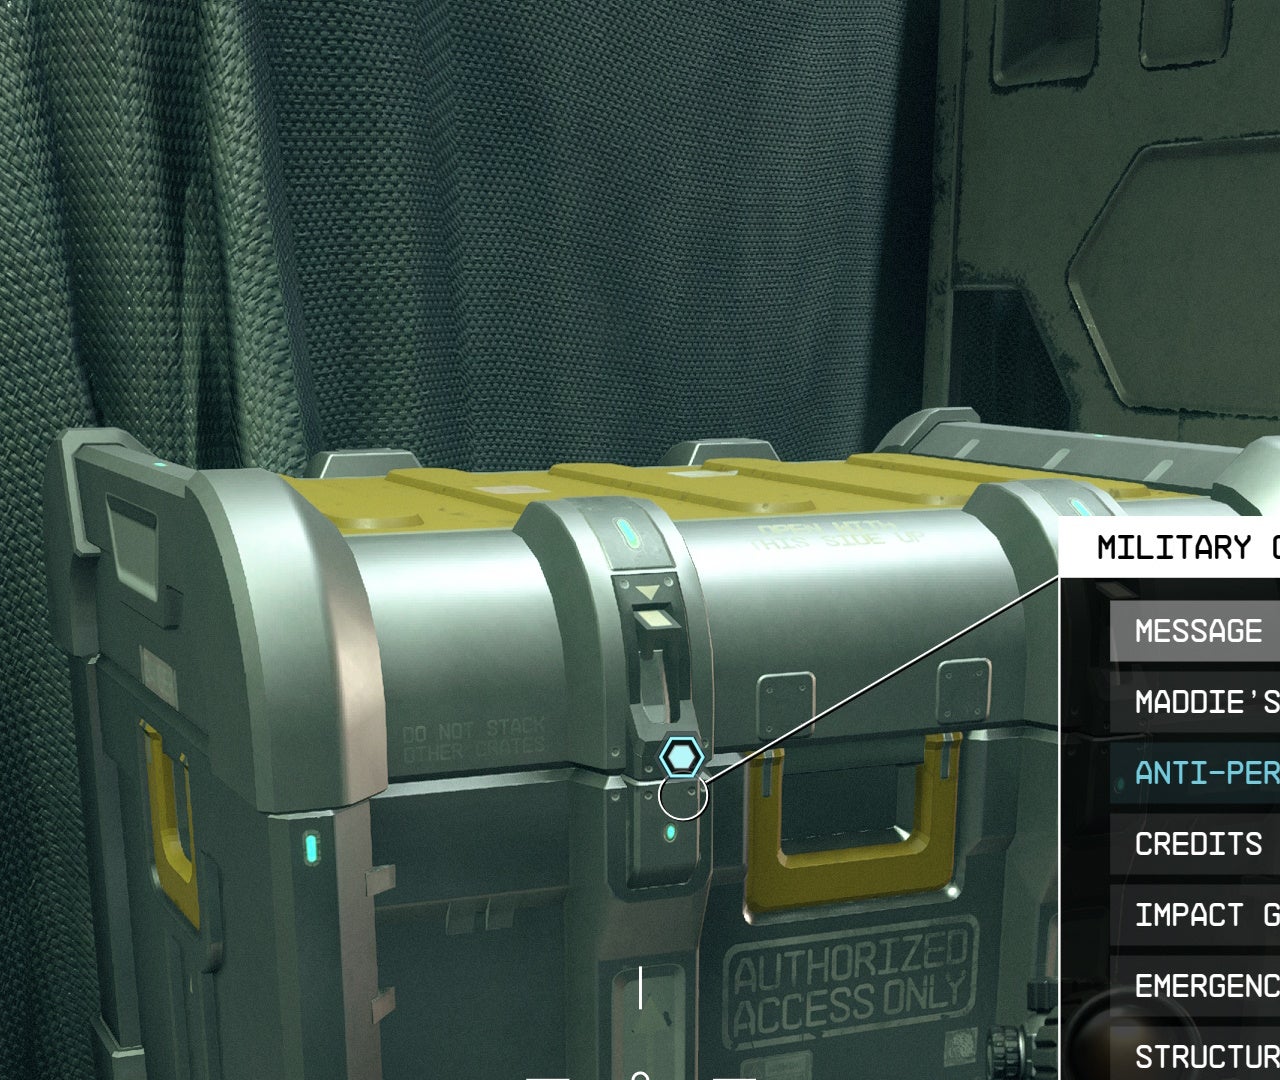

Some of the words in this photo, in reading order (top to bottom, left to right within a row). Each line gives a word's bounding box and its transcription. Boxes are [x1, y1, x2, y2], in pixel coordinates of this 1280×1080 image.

[822, 531, 886, 547] SIDE
[402, 725, 427, 743] DO
[439, 721, 474, 741] NOT
[487, 716, 545, 736] STACK
[734, 929, 968, 995] AUTHORIZED
[733, 983, 875, 1038] ACCESS
[883, 969, 967, 1016] ONLY
